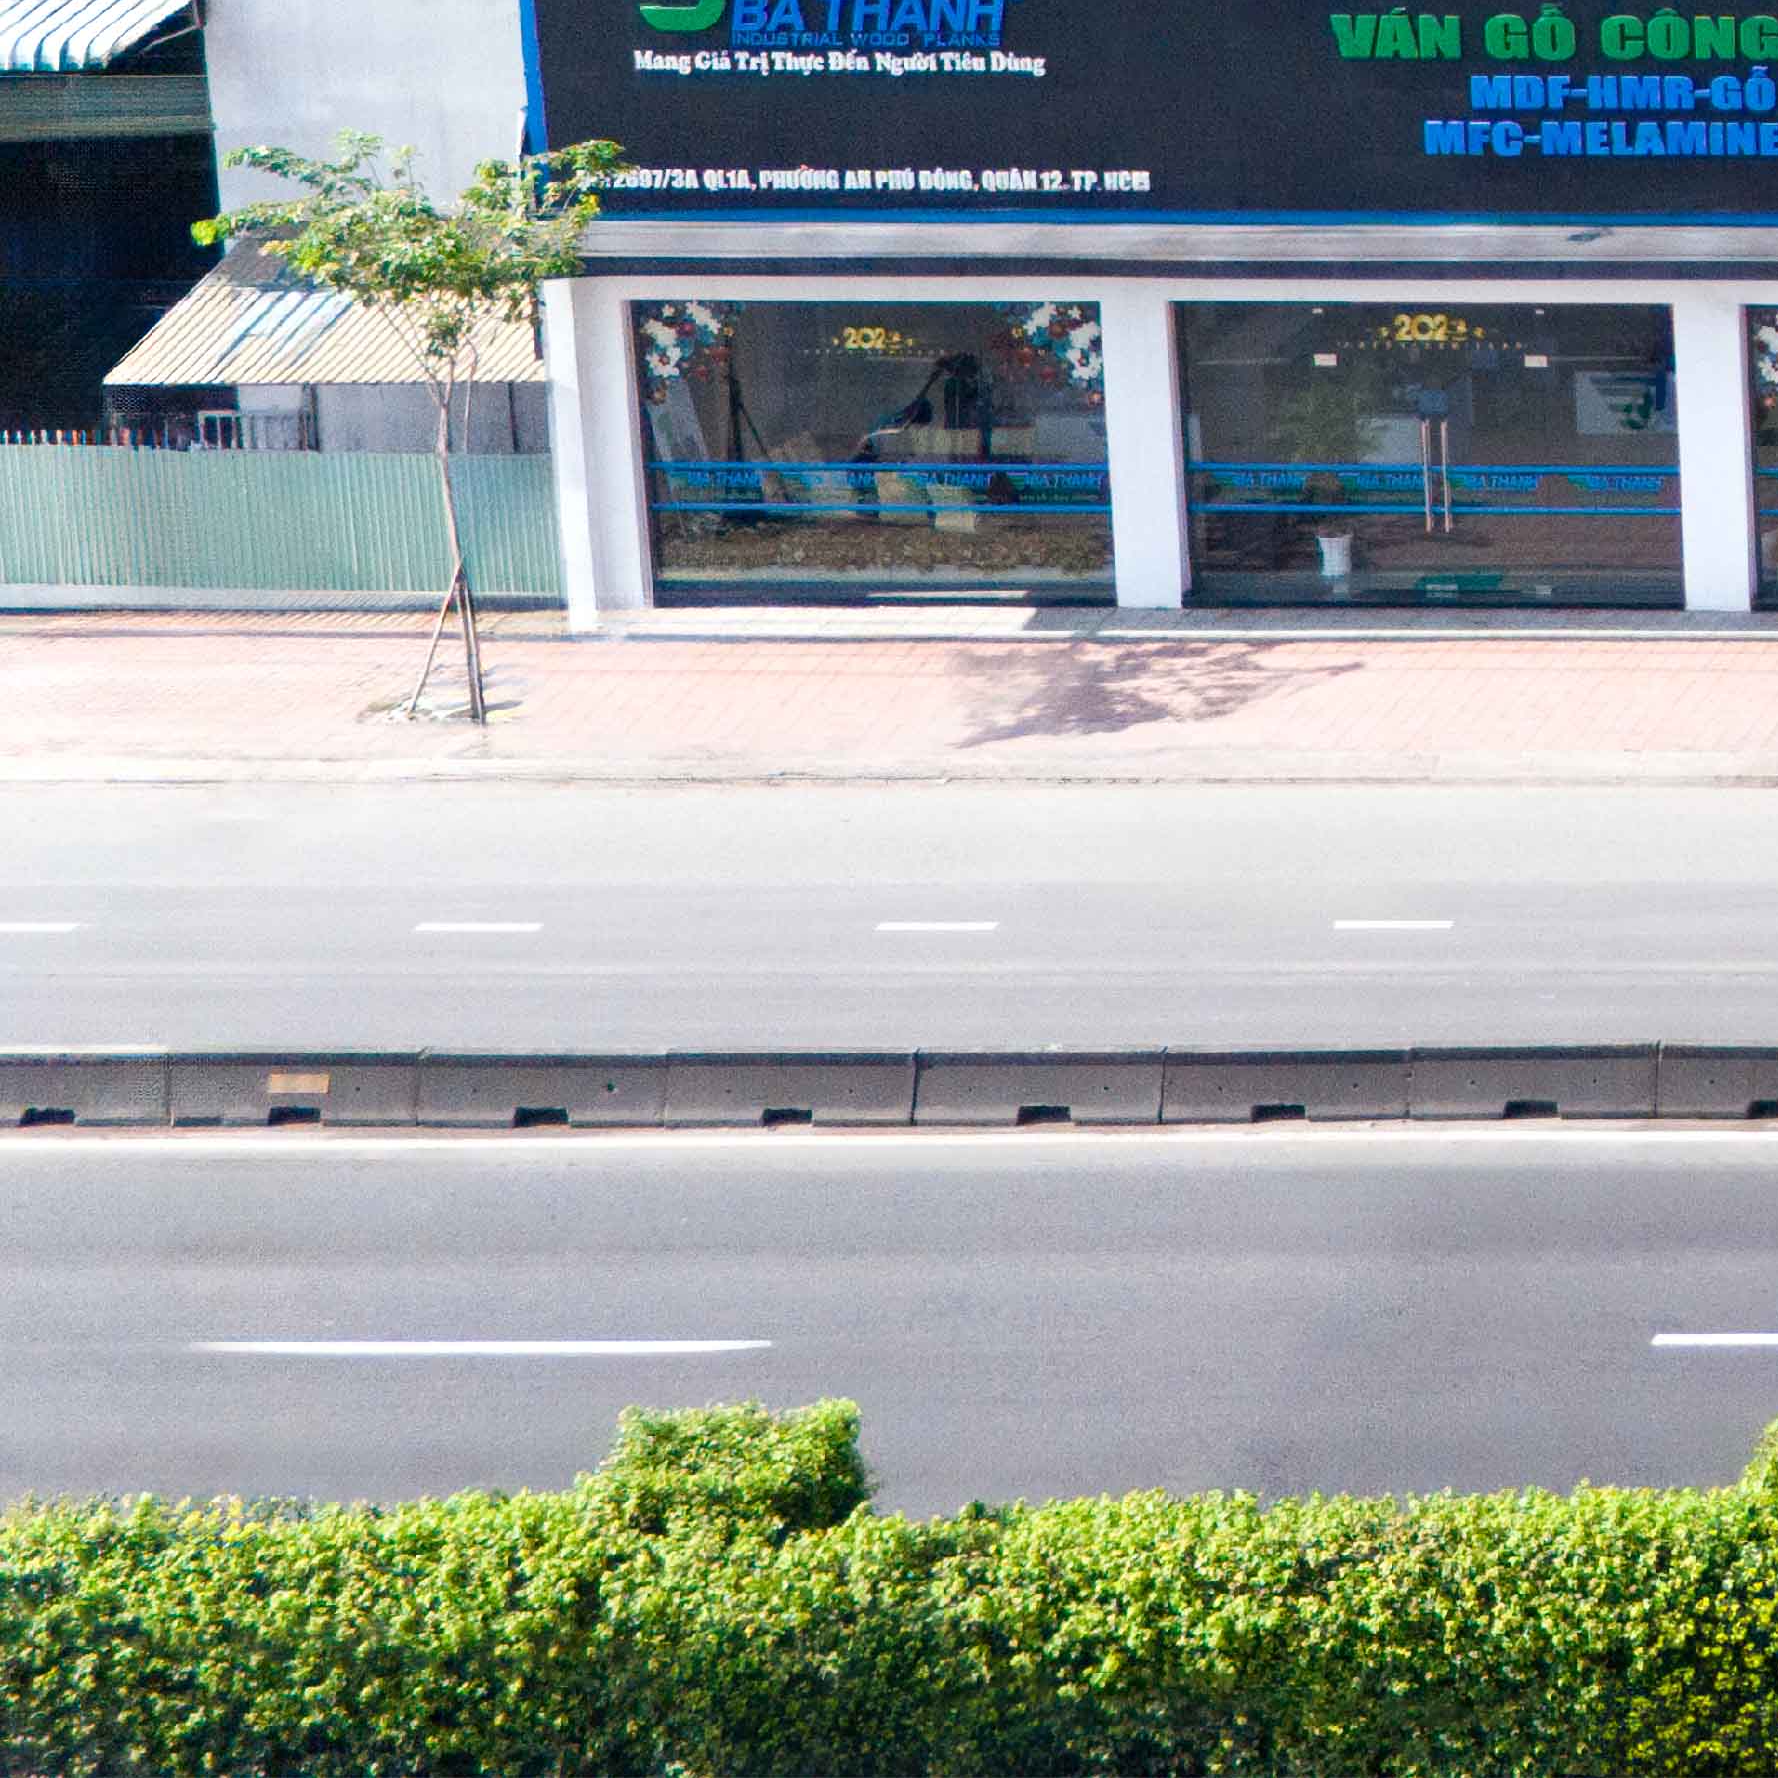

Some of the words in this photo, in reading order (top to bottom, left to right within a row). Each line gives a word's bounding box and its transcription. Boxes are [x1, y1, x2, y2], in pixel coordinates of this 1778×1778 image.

[733, 33, 844, 48] INDUSTRIAL
[851, 33, 910, 48] WOOD
[924, 33, 1001, 48] PLANKS
[1330, 6, 1462, 60] VÁN
[1484, 3, 1577, 60] GỖ
[634, 51, 692, 74] Mang
[695, 49, 731, 71] Giá
[735, 50, 769, 75] Trị
[771, 51, 824, 76] Thực
[828, 48, 869, 71] Đến
[940, 50, 986, 71] Tiêu
[991, 51, 1046, 76] Dùng
[1470, 66, 1776, 111] MDF-HMR-GỖ
[844, 170, 871, 190] AN
[875, 167, 915, 190] PHÚ
